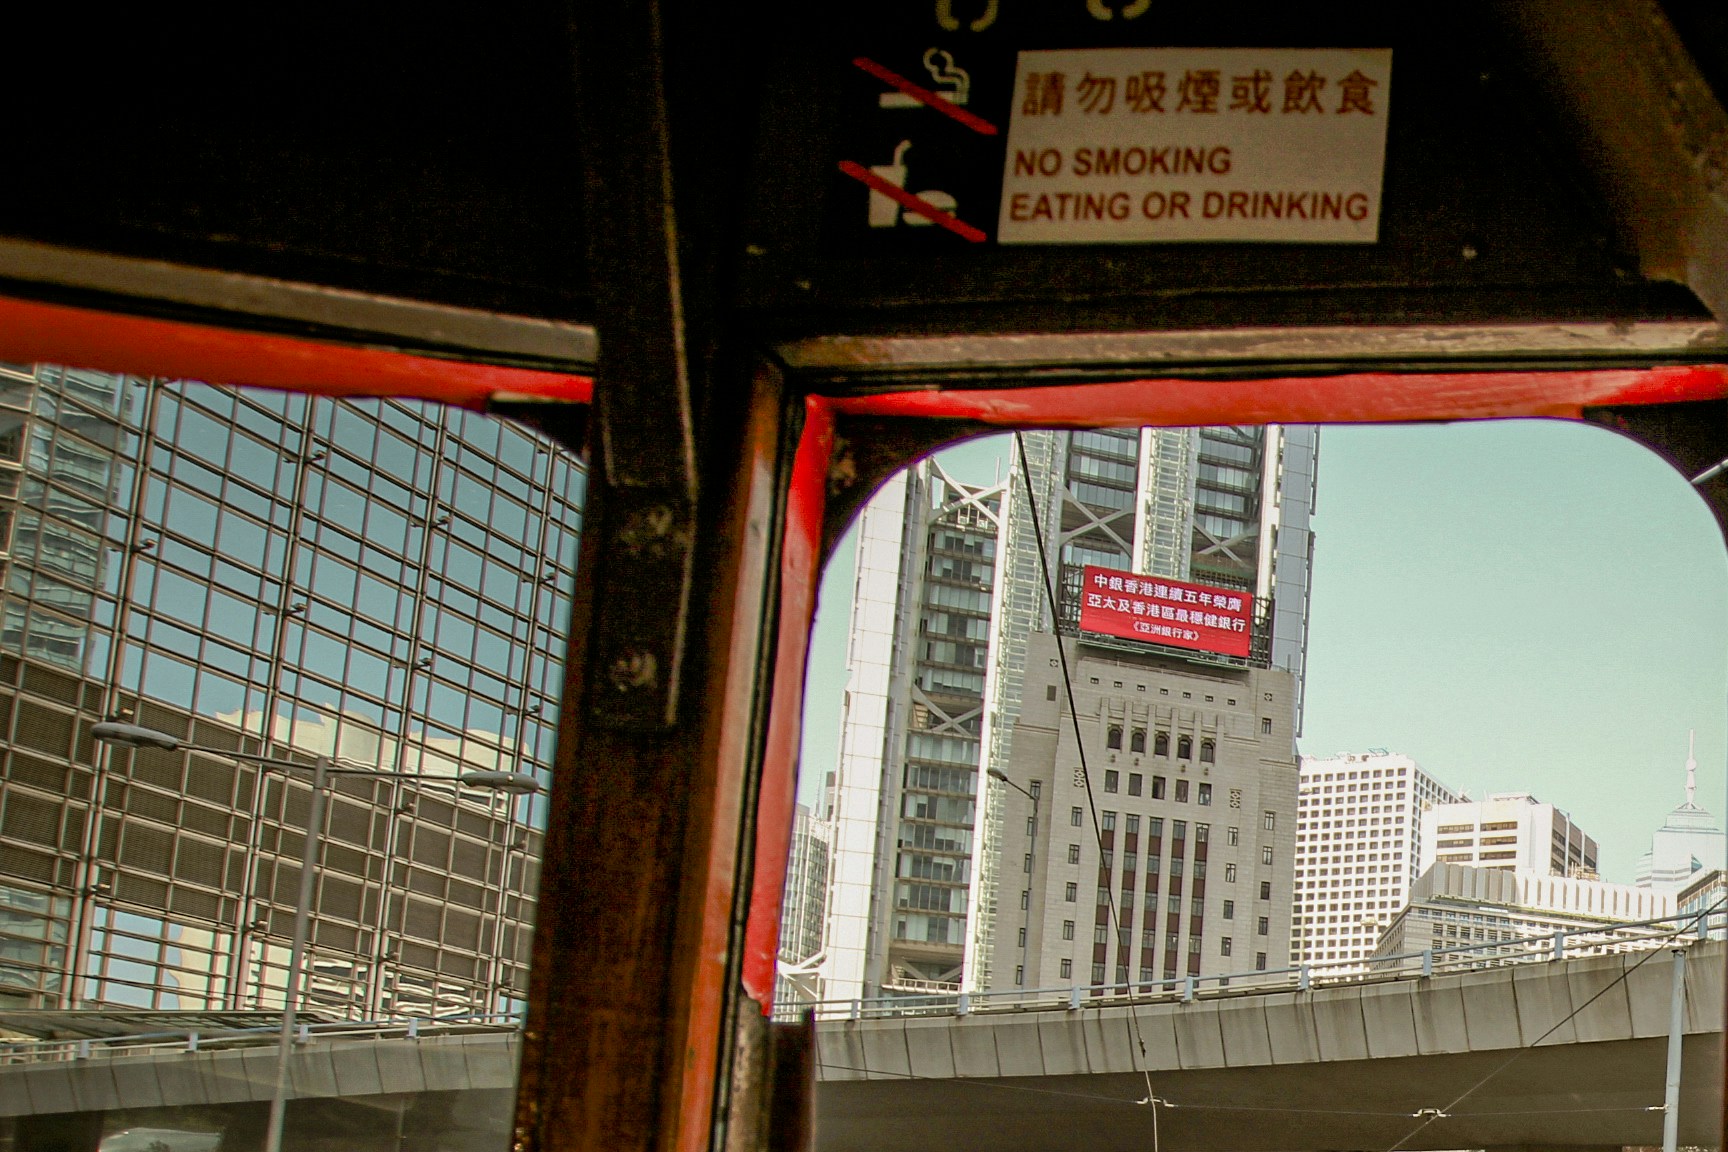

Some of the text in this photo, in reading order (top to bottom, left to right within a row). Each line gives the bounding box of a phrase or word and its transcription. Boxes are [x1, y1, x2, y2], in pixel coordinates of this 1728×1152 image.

[1022, 70, 1378, 117] 請勿吸煙或飲食
[1013, 147, 1233, 177] NO SMOKING
[1009, 192, 1369, 222] EATING OR DRINKING
[1086, 592, 1247, 633] 亞太及香港區最穩健銀行
